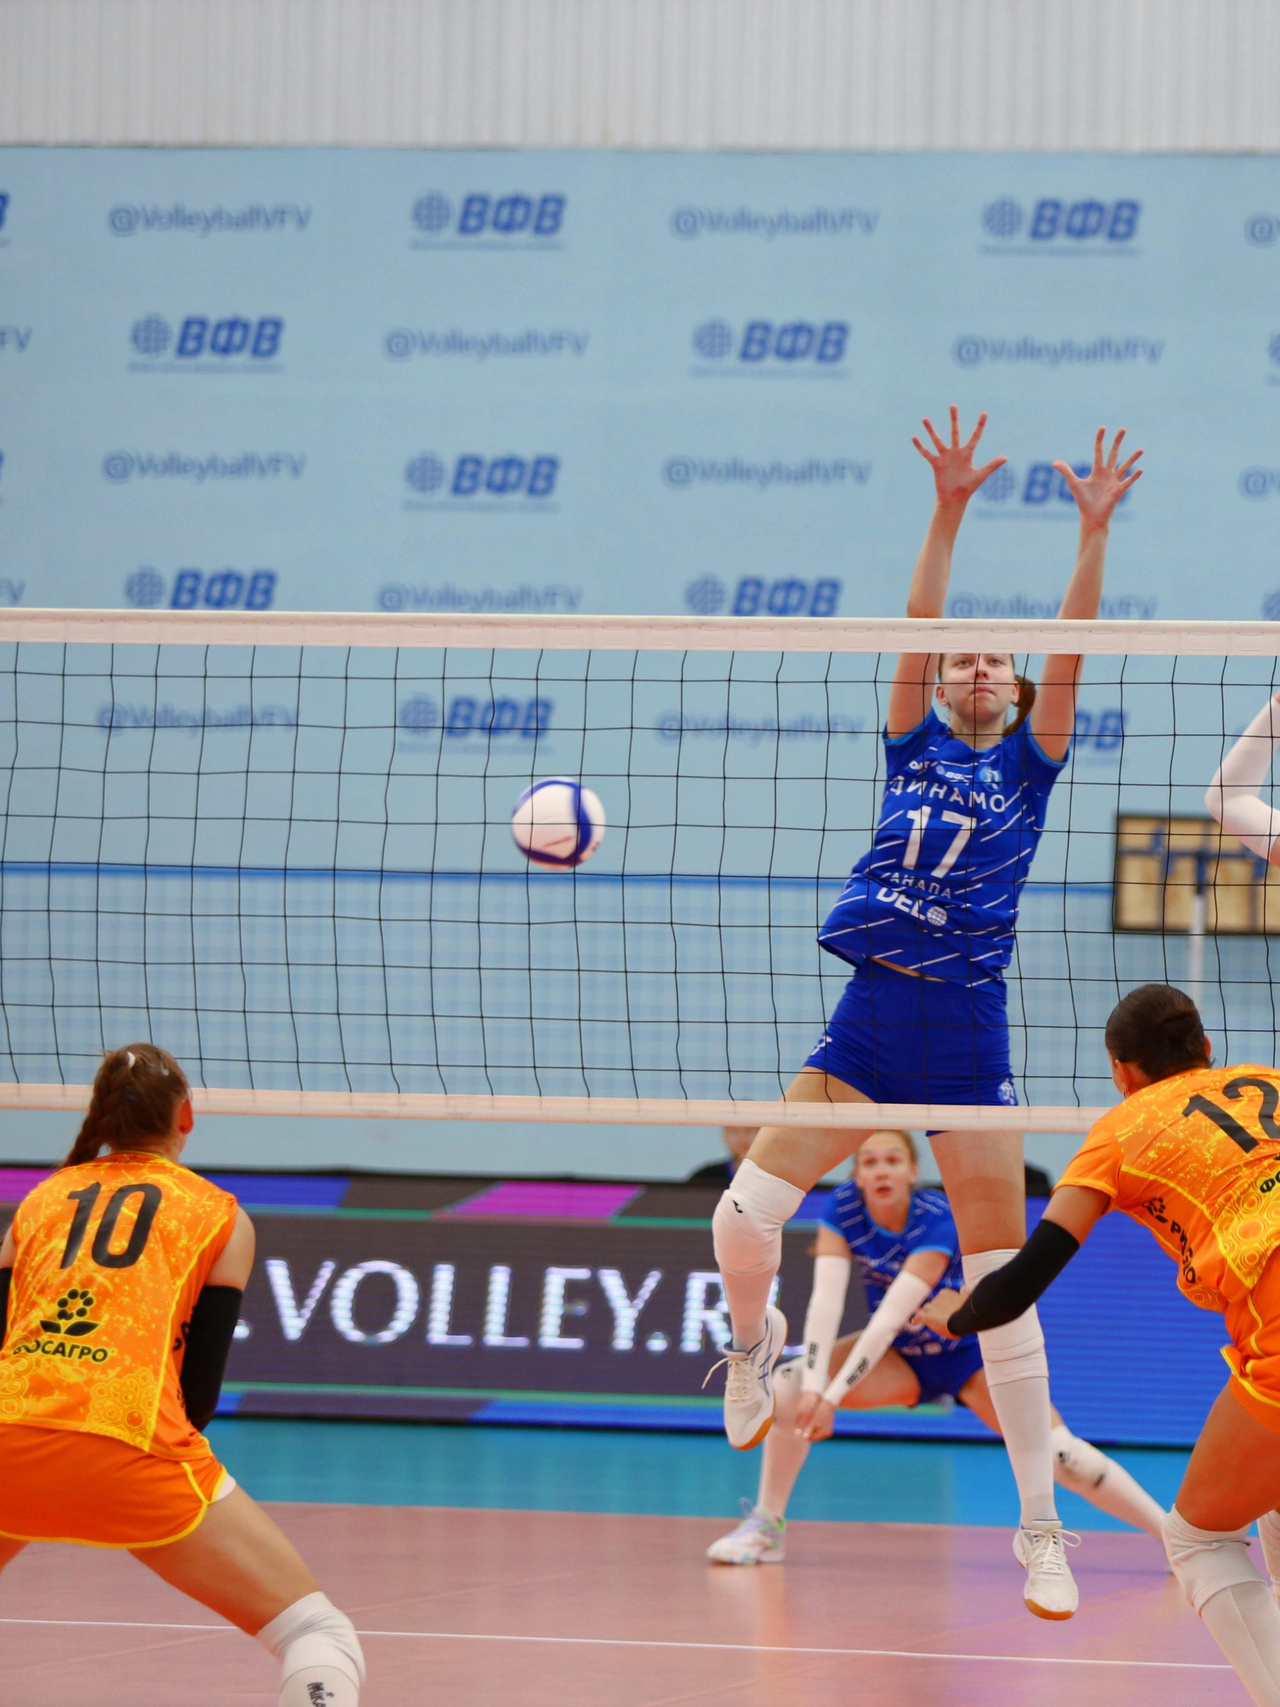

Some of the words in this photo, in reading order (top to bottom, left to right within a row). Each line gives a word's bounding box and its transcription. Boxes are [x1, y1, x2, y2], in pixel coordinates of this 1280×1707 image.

[108, 203, 311, 238] @VolleyballVFV
[457, 191, 567, 237] ВФВ
[672, 207, 879, 241] @VolleyballVFV
[1029, 197, 1142, 243] ВФВ
[175, 315, 285, 360] ВФВ
[384, 328, 590, 362] @VolleyballVFV
[739, 319, 851, 364] ВФВ
[953, 334, 1165, 368] @VolleyballVFV
[103, 450, 306, 485] @VolleyballVFV
[450, 453, 561, 499] ВФВ
[663, 455, 872, 489] @VolleyballVFV
[169, 567, 278, 611] ВФВ
[731, 575, 844, 617] ВФВ
[444, 696, 554, 741] ВФВ
[902, 804, 977, 879] 17
[890, 871, 952, 900] АНАПА
[60, 1181, 163, 1270] 10
